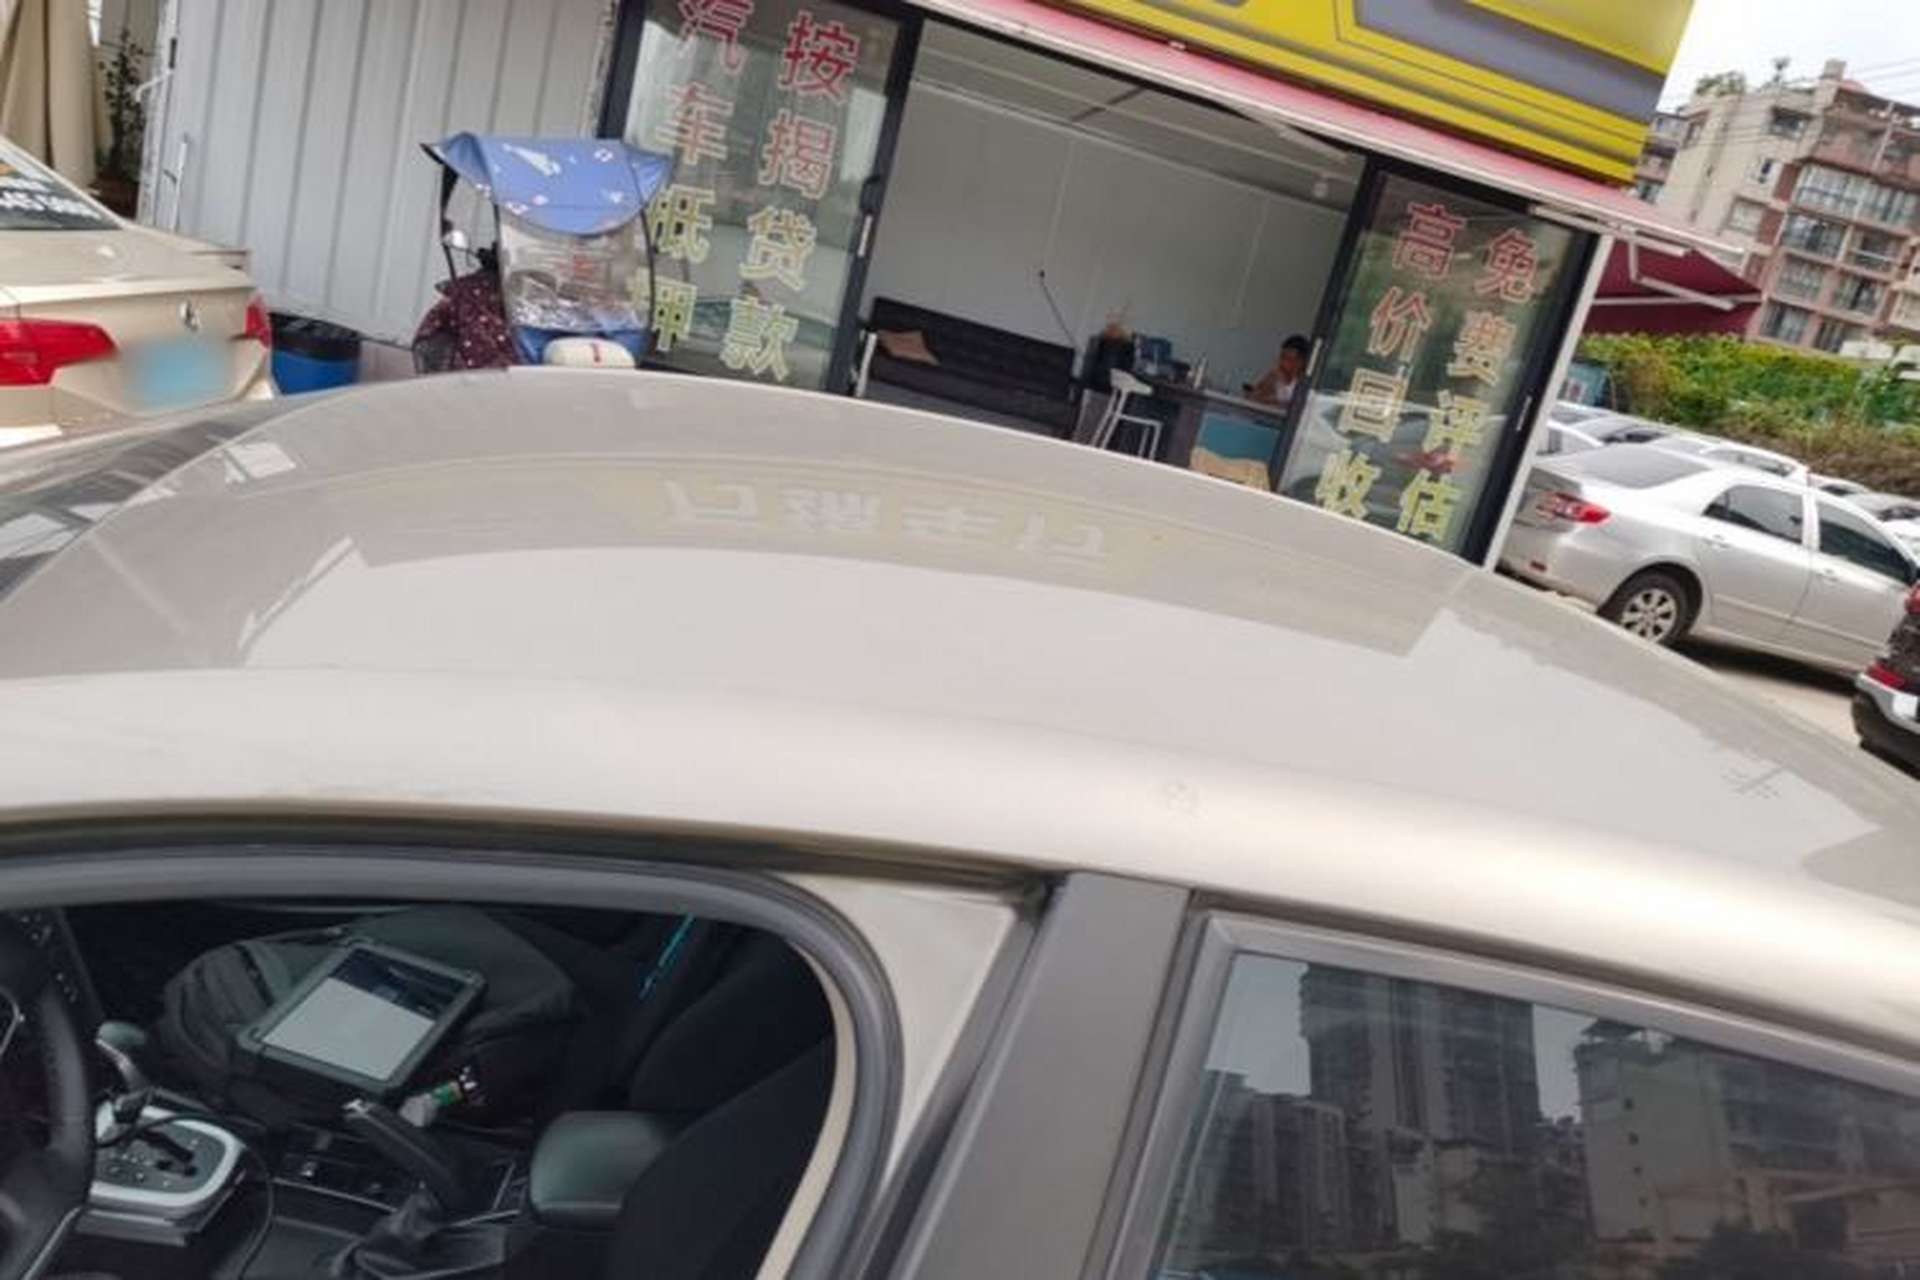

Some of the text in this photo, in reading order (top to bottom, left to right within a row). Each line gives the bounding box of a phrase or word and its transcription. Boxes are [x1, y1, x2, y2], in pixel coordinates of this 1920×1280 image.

[719, 10, 861, 381] 按揭贷款
[1314, 202, 1468, 519] 高价回收
[1396, 227, 1539, 539] 免费评估
